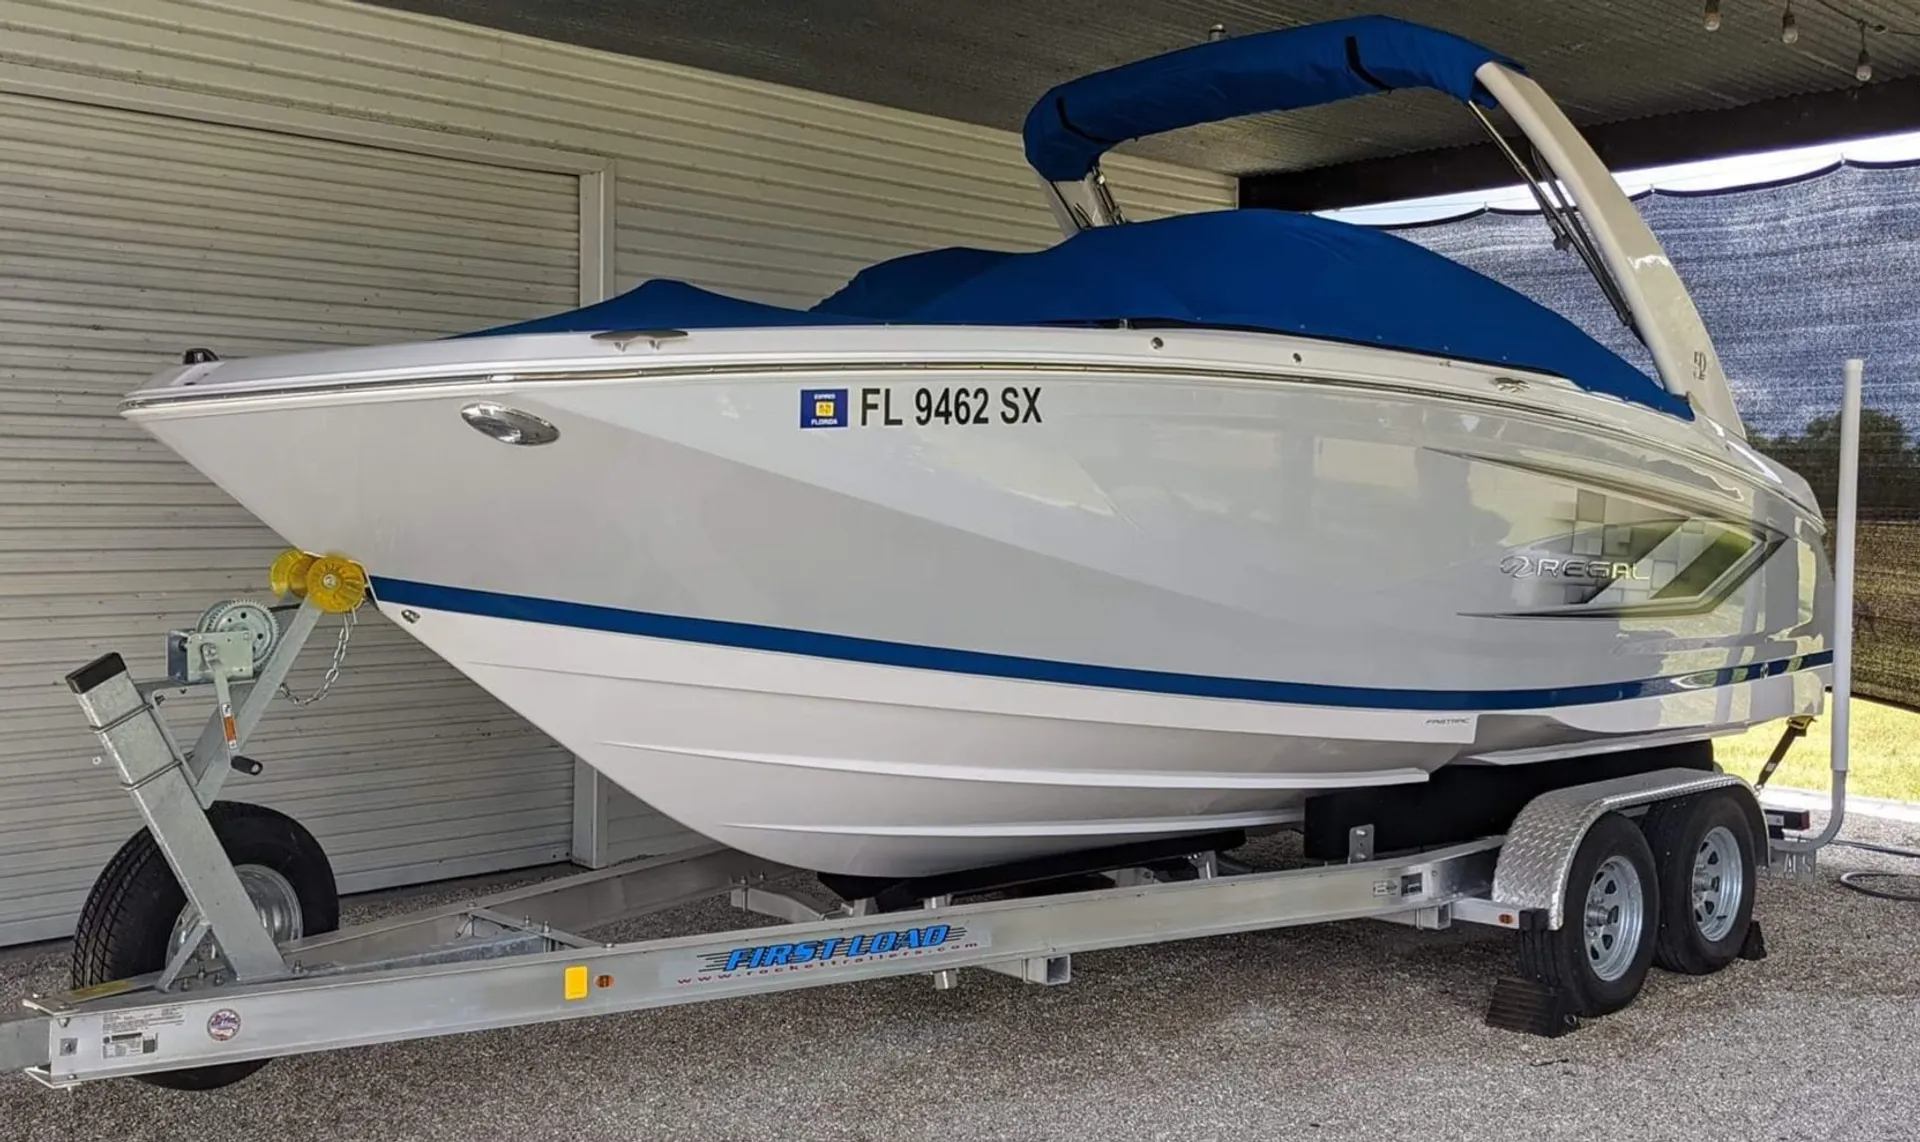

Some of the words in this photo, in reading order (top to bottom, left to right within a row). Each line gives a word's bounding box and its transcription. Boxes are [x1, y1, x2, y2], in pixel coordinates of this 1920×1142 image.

[861, 388, 903, 426] FL
[915, 387, 989, 425] 9462
[1000, 386, 1042, 424] SX
[811, 418, 838, 426] FLORIDA
[1535, 558, 1650, 580] REGAL
[723, 936, 845, 972] FIRST
[847, 924, 951, 958] LOAD
